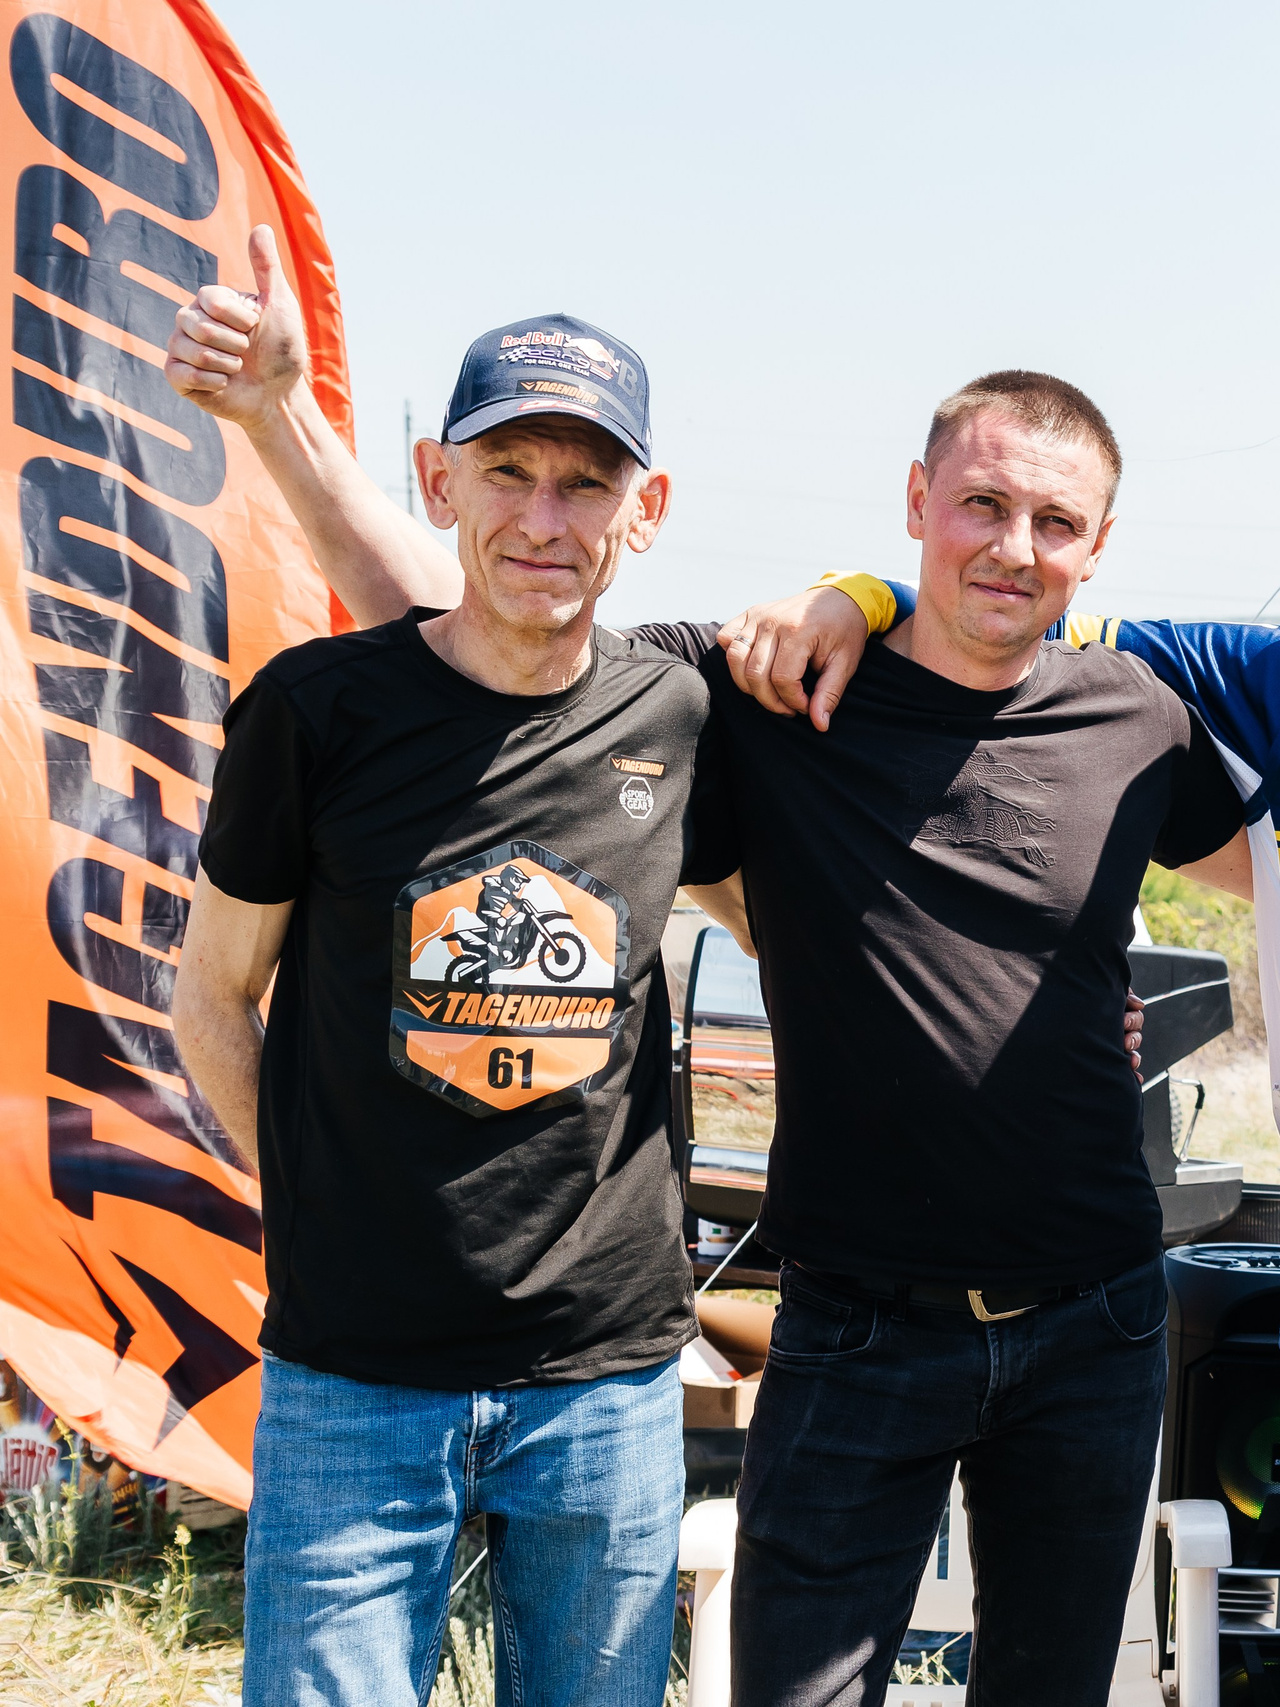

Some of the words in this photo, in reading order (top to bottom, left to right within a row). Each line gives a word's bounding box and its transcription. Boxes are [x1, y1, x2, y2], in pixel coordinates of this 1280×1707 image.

[501, 332, 532, 348] Red
[531, 332, 564, 347] Bull
[573, 366, 590, 377] TEAM
[534, 381, 599, 405] TAGENDURO
[9, 12, 263, 1256] TAGENDURO
[620, 759, 665, 776] TAGENDURO
[627, 789, 647, 798] SPORT
[627, 800, 648, 811] GEAR
[442, 992, 616, 1030] TAGENDURO
[487, 1046, 534, 1090] 61
